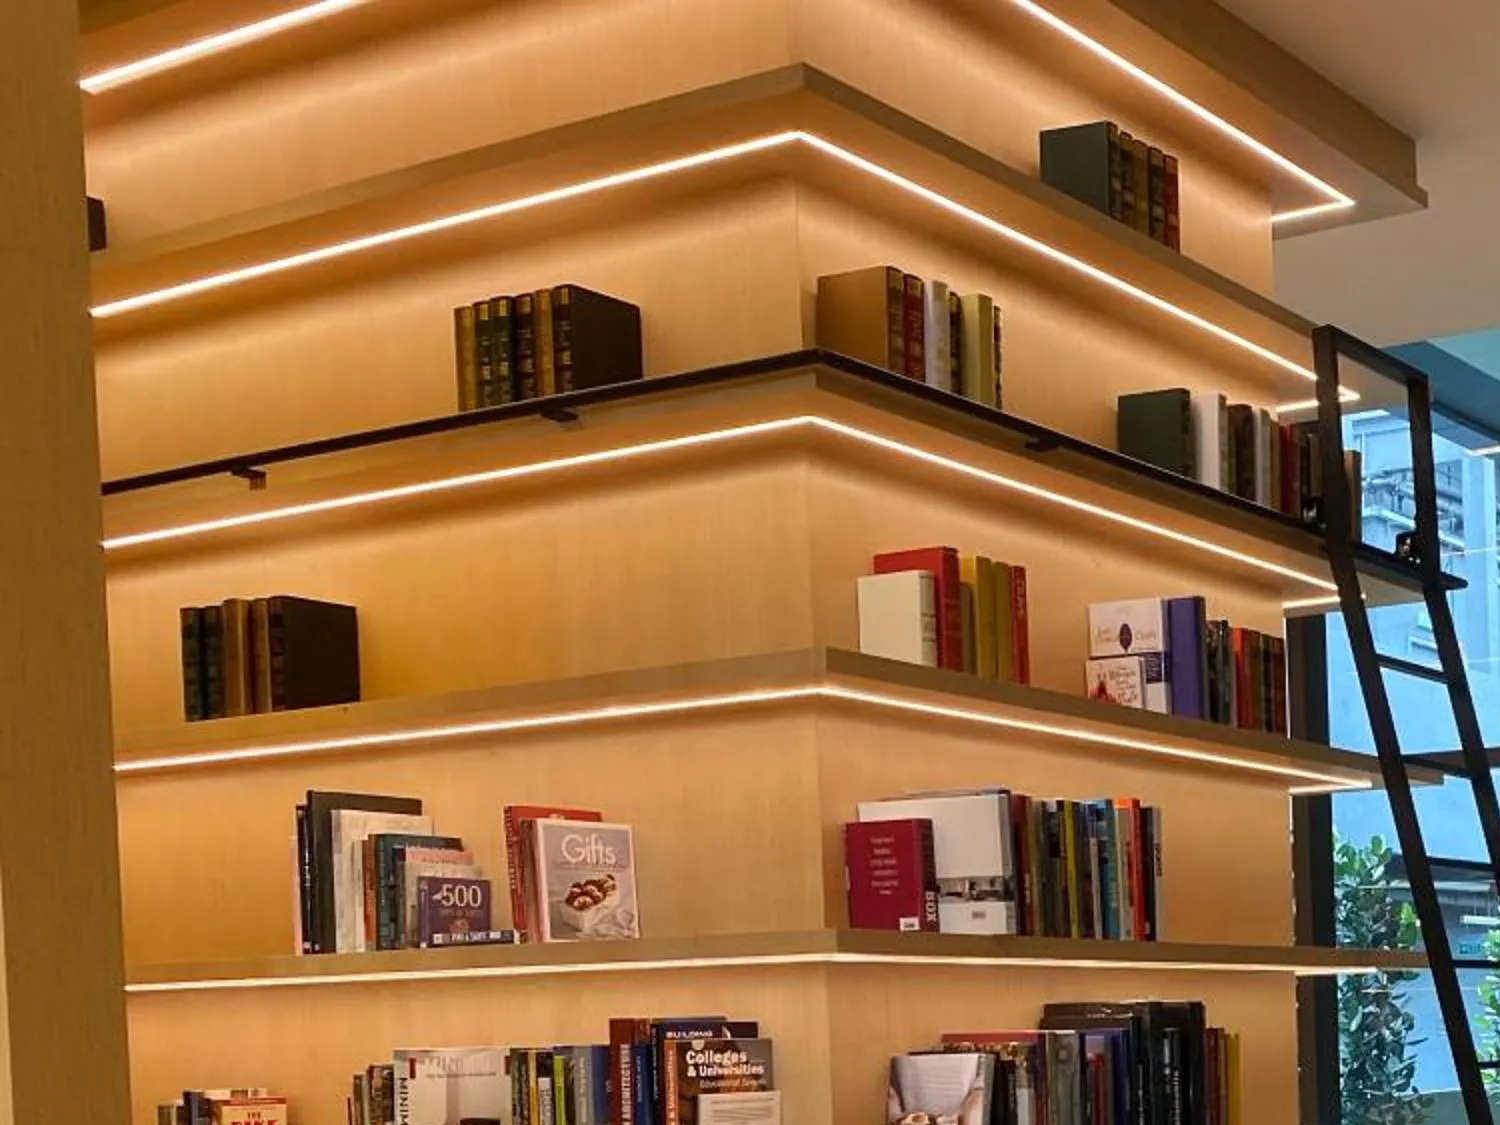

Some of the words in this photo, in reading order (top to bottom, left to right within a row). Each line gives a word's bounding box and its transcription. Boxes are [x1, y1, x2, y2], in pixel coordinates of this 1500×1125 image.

[561, 833, 617, 865] Gifts
[441, 884, 482, 908] 500
[685, 1050, 748, 1067] Colleges
[687, 1065, 697, 1077] &
[699, 1063, 765, 1077] Universities
